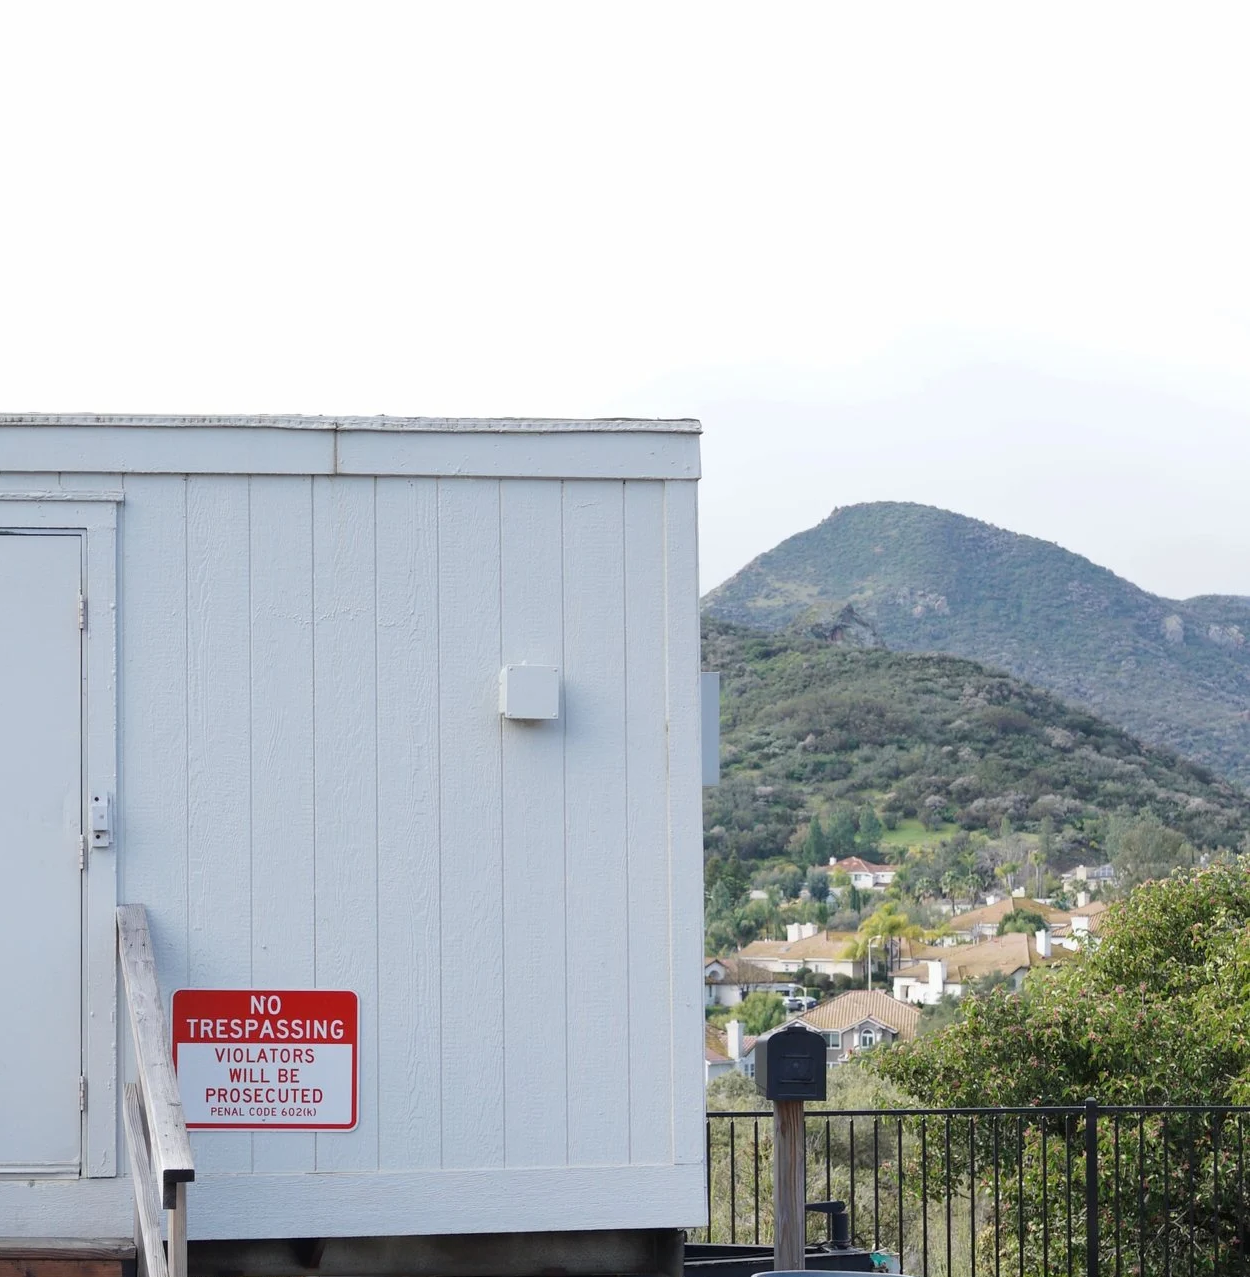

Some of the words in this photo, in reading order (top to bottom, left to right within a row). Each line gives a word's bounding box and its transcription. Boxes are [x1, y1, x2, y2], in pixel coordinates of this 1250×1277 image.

[250, 995, 282, 1015] NO
[186, 1019, 344, 1039] TRESPASSING
[215, 1048, 315, 1063] VIOLATORS
[229, 1068, 270, 1083] WILL
[278, 1068, 300, 1083] BE
[205, 1088, 323, 1103] PROSECUTED
[210, 1107, 245, 1117] PENAL
[249, 1107, 277, 1117] CODE
